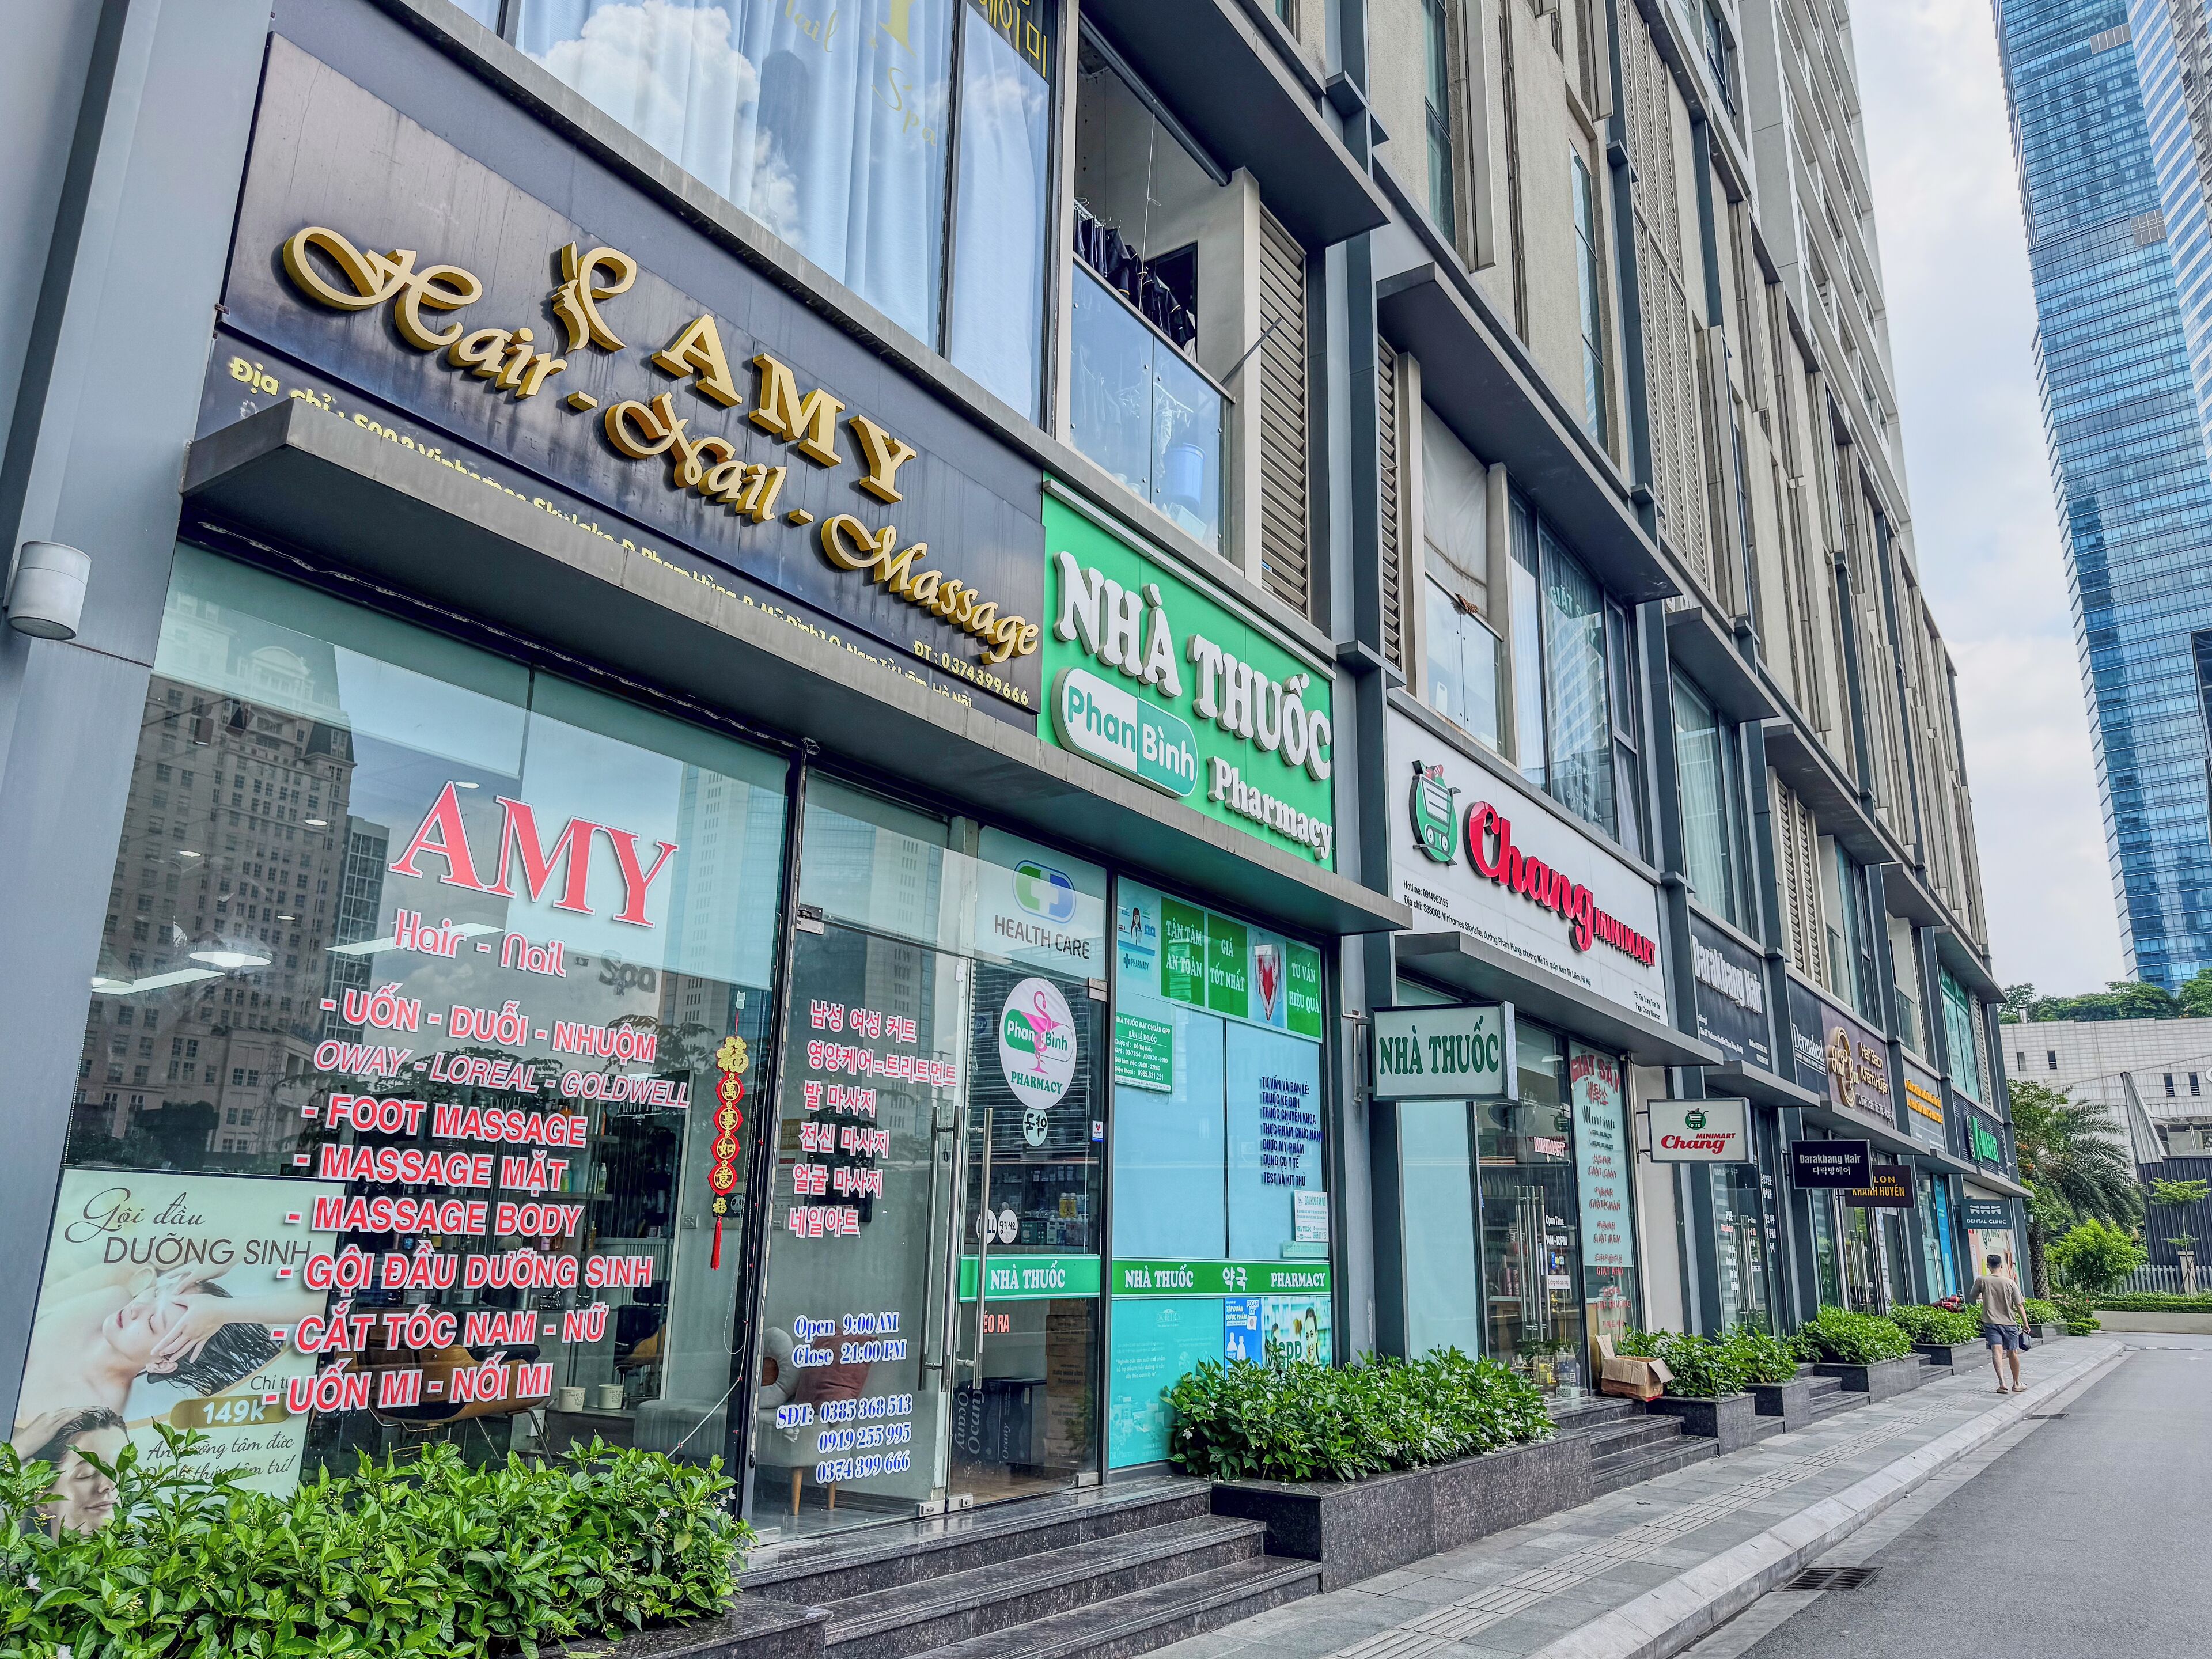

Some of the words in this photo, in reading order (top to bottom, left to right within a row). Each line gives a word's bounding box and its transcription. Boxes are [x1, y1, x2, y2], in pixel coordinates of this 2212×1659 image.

[785, 0, 839, 52] ail
[871, 67, 937, 146] Spa
[230, 357, 279, 396] Địa
[652, 314, 917, 503] AMY
[821, 514, 1037, 665] Massage
[1053, 551, 1183, 698] NHÀ
[1187, 634, 1331, 781] THUỐC
[1207, 755, 1333, 860] Pharmacy
[388, 780, 680, 929] AMY
[1463, 801, 1594, 952] Chang
[1593, 907, 1656, 967] MINIMART
[1442, 911, 1464, 929] Vinhomes
[392, 908, 468, 959] Hair
[500, 931, 567, 978] Nail
[599, 949, 657, 995] Spa
[994, 914, 1051, 950] HEALTH
[1055, 933, 1090, 960] CARE
[1221, 937, 1234, 958] GIÁ
[1131, 957, 1149, 971] PHARMACY
[1210, 962, 1225, 987] TỐT
[1225, 968, 1245, 993] NHẤT
[1302, 962, 1316, 983] VẤN
[1289, 988, 1305, 1012] HIỆU
[1306, 993, 1320, 1014] QUẢ
[343, 983, 422, 1033] UỐN
[449, 1000, 529, 1047] DUỖI
[552, 1020, 658, 1065] NHUỘM
[810, 999, 844, 1033] 남성
[849, 1007, 882, 1040] 여성
[885, 1014, 918, 1044] 커트
[1007, 1020, 1035, 1043] Phan
[1124, 1017, 1138, 1027] THUỐC
[1379, 1025, 1424, 1075] NHÀ
[1428, 1015, 1499, 1075] THUỐC
[313, 1038, 414, 1079] OWAY
[428, 1051, 540, 1094] LOREAL
[560, 1071, 691, 1109] GOLDWELL
[1010, 1070, 1063, 1094] PHARMACY
[1282, 1078, 1289, 1092] VÀ
[804, 1080, 823, 1111] 발
[827, 1084, 877, 1118] 마사지
[1262, 1091, 1280, 1105] THUỐC
[324, 1093, 428, 1137] FOOT
[432, 1103, 589, 1149] MASSAGE
[1262, 1105, 1280, 1119] THUỐC
[1302, 1112, 1316, 1124] KHOA
[799, 1122, 836, 1154] 전신
[841, 1126, 890, 1159] 마사지
[1533, 1136, 1565, 1157] MINIMART
[1661, 1134, 1726, 1154] Chang
[319, 1143, 496, 1189] MASSAGE
[499, 1150, 569, 1198] MẶT
[1800, 1154, 1842, 1165] Darakbang
[1844, 1154, 1861, 1164] Hair
[1813, 1166, 1851, 1176] 다락방헤어
[793, 1163, 828, 1196] 얼굴
[833, 1166, 884, 1199] 마사지
[1263, 1172, 1277, 1184] TEST
[1278, 1171, 1286, 1185] VÀ
[65, 1187, 145, 1243] Gội
[153, 1192, 207, 1226] đầu
[311, 1195, 488, 1236] MASSAGE
[494, 1201, 586, 1238] BODY
[789, 1206, 861, 1239] 네일아트
[104, 1234, 235, 1265] DƯỠNG
[243, 1240, 312, 1266] SINH
[304, 1243, 376, 1297] GỘI
[380, 1239, 459, 1291] ĐẦU
[463, 1247, 577, 1289] DƯỠNG
[585, 1255, 654, 1289] SINH
[990, 1263, 1020, 1290] NHÀ
[1022, 1259, 1066, 1289] THUỐC
[1124, 1264, 1152, 1289] NHÀ
[1154, 1263, 1194, 1289] THUỐC
[1222, 1266, 1248, 1292] 약국
[1270, 1272, 1326, 1288] PHARMACY
[294, 1298, 378, 1355] CẮT
[385, 1303, 459, 1351] TÓC
[463, 1311, 539, 1347] NAM
[562, 1301, 610, 1343] NỮ
[794, 1315, 836, 1343] Open
[842, 1312, 876, 1336] 9:00
[875, 1311, 900, 1335] AM
[997, 1313, 1010, 1333] RA
[791, 1344, 835, 1368] Close
[840, 1340, 881, 1365] 21:00
[881, 1339, 908, 1362] PM
[251, 1374, 277, 1391] Chỉ
[286, 1357, 372, 1415] UỐN
[377, 1369, 423, 1408] MI
[449, 1351, 511, 1404] NỐI
[516, 1362, 554, 1398] MI
[203, 1399, 266, 1425] 149k
[819, 1398, 857, 1424] 0385
[857, 1395, 886, 1419] 368
[885, 1393, 914, 1416] 513
[232, 1437, 263, 1453] tâm
[266, 1431, 294, 1449] đức
[817, 1427, 855, 1454] 0919
[855, 1423, 884, 1450] 255
[884, 1421, 912, 1445] 995
[816, 1457, 854, 1484] 0374
[854, 1454, 883, 1478] 399
[883, 1449, 911, 1474] 666
